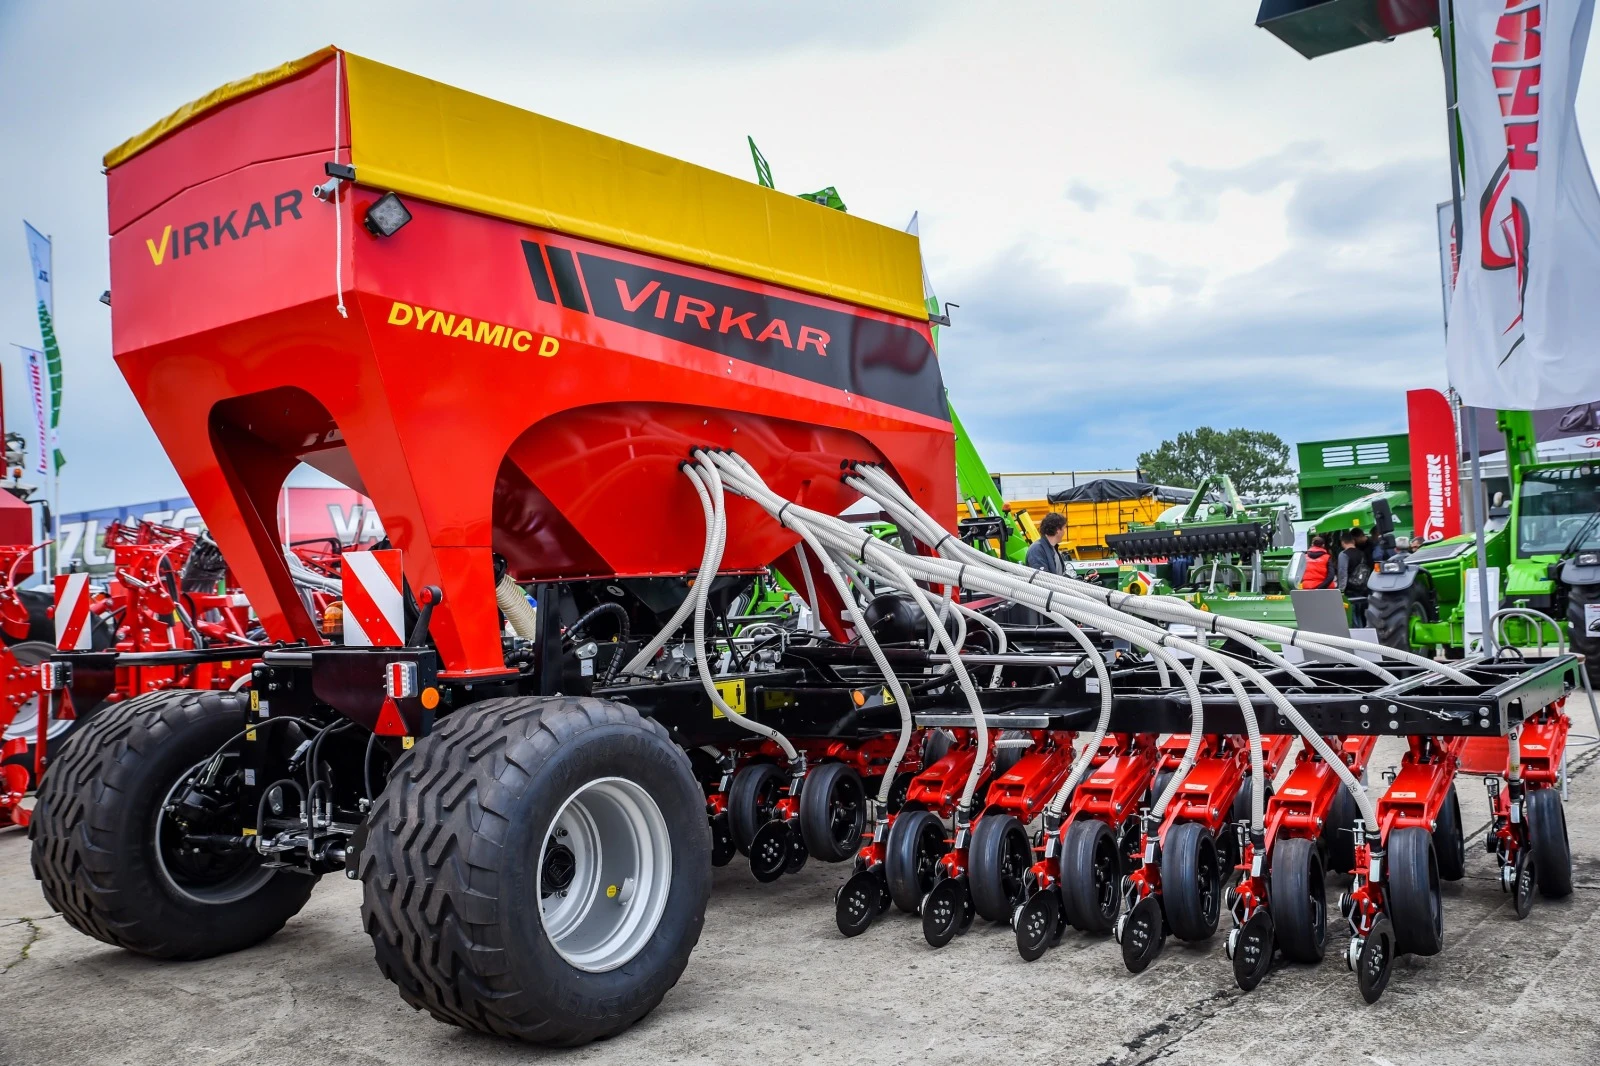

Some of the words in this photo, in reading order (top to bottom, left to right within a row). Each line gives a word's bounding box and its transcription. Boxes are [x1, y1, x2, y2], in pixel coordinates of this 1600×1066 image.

[146, 188, 303, 267] VIRKAR
[388, 302, 533, 353] DYNAMIC
[538, 336, 561, 358] D
[614, 278, 832, 357] VIRKAR
